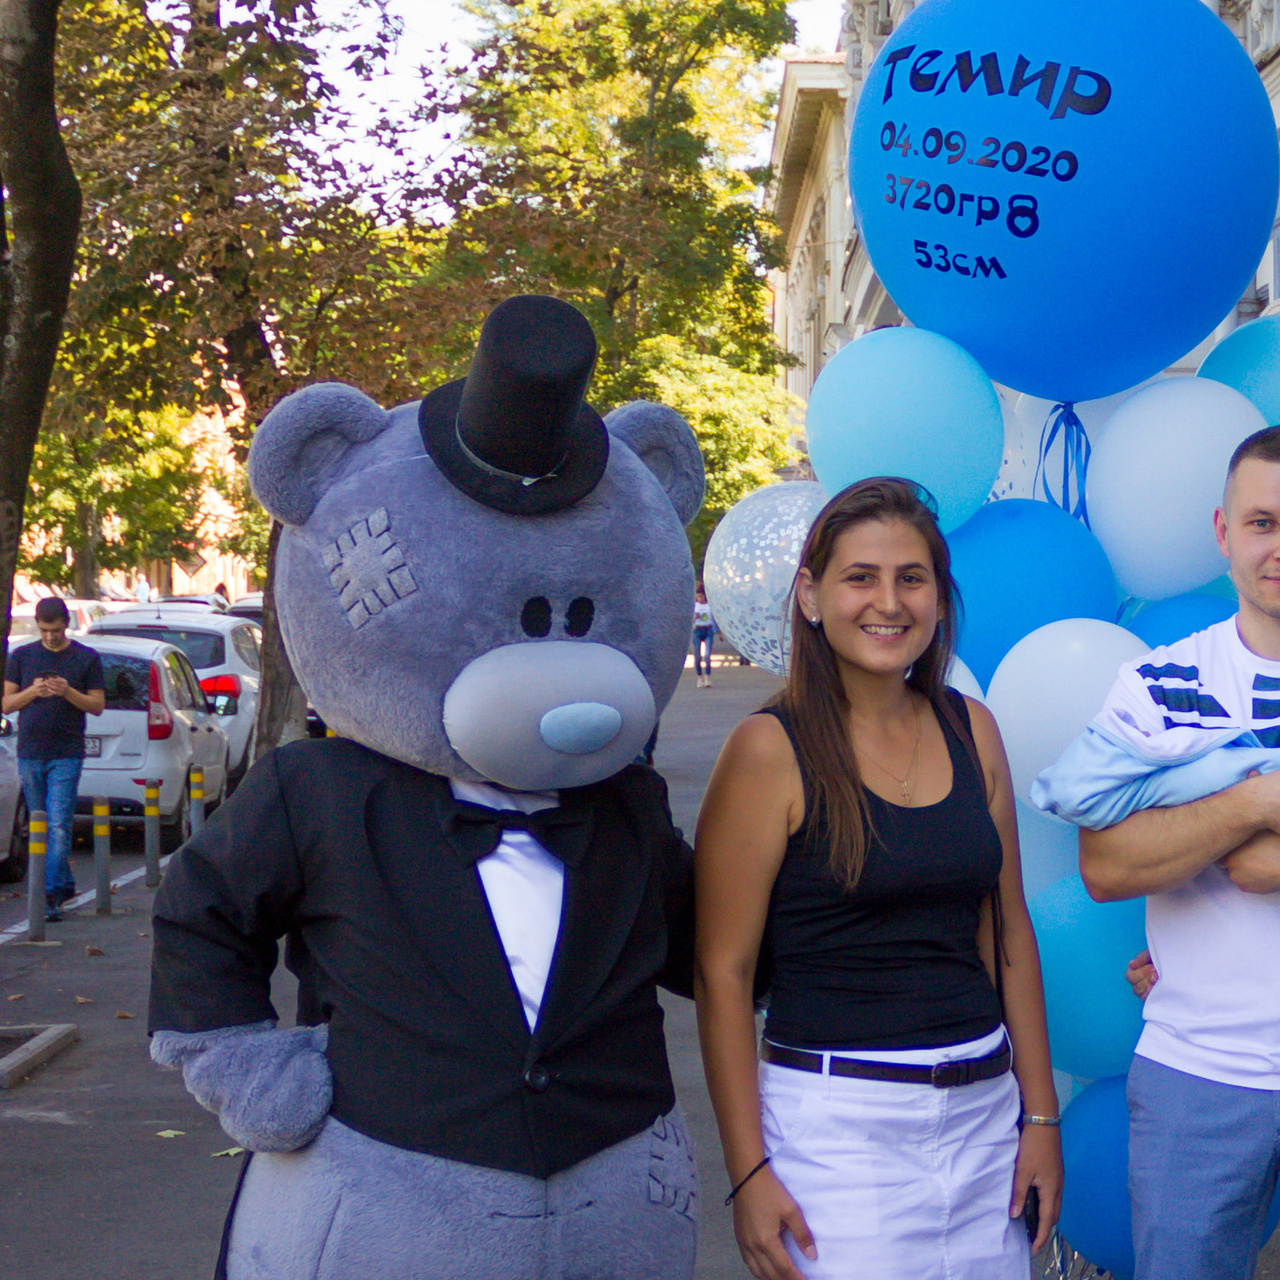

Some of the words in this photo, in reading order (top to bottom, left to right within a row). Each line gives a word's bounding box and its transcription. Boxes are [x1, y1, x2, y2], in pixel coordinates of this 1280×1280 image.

[881, 43, 1112, 120] Темир
[880, 120, 1079, 182] 04.09.2020
[884, 173, 1000, 226] 3720гр
[913, 239, 1008, 279] 53см
